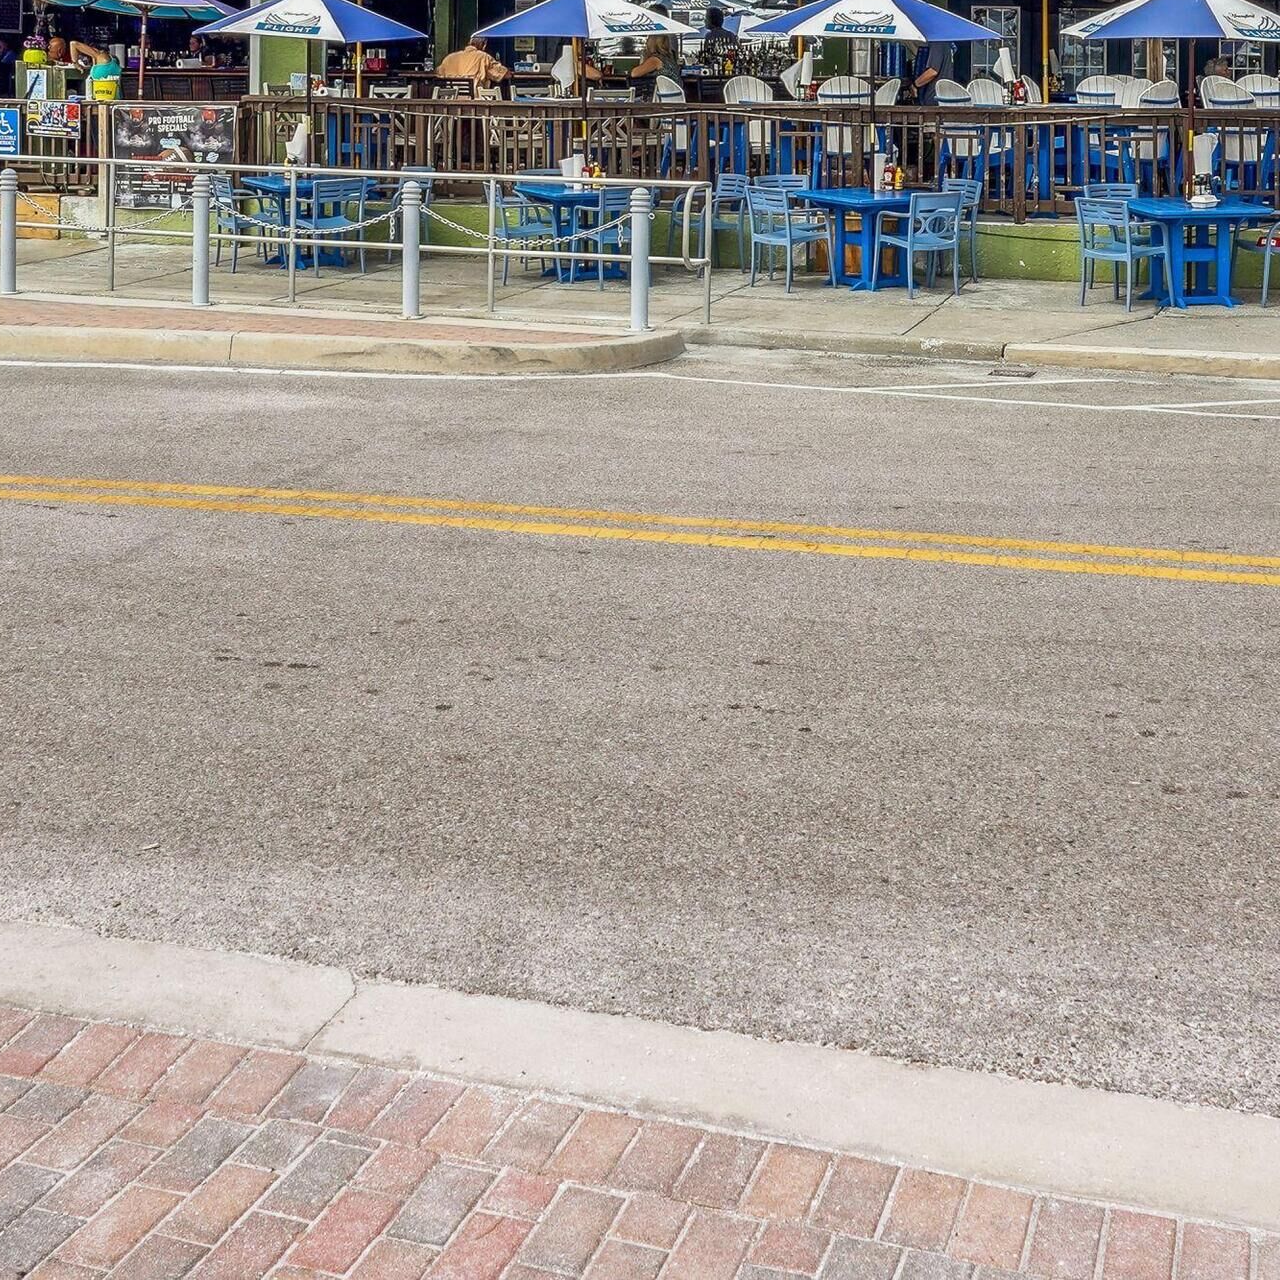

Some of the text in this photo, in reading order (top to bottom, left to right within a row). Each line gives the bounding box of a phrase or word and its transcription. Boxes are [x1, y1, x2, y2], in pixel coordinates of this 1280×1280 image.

[263, 24, 313, 33] FLIGHT
[613, 24, 657, 32] FLIGHT
[834, 25, 888, 33] FLIGHT
[148, 115, 195, 125] PRO FOOTBALL
[157, 123, 188, 132] SPECIALS
